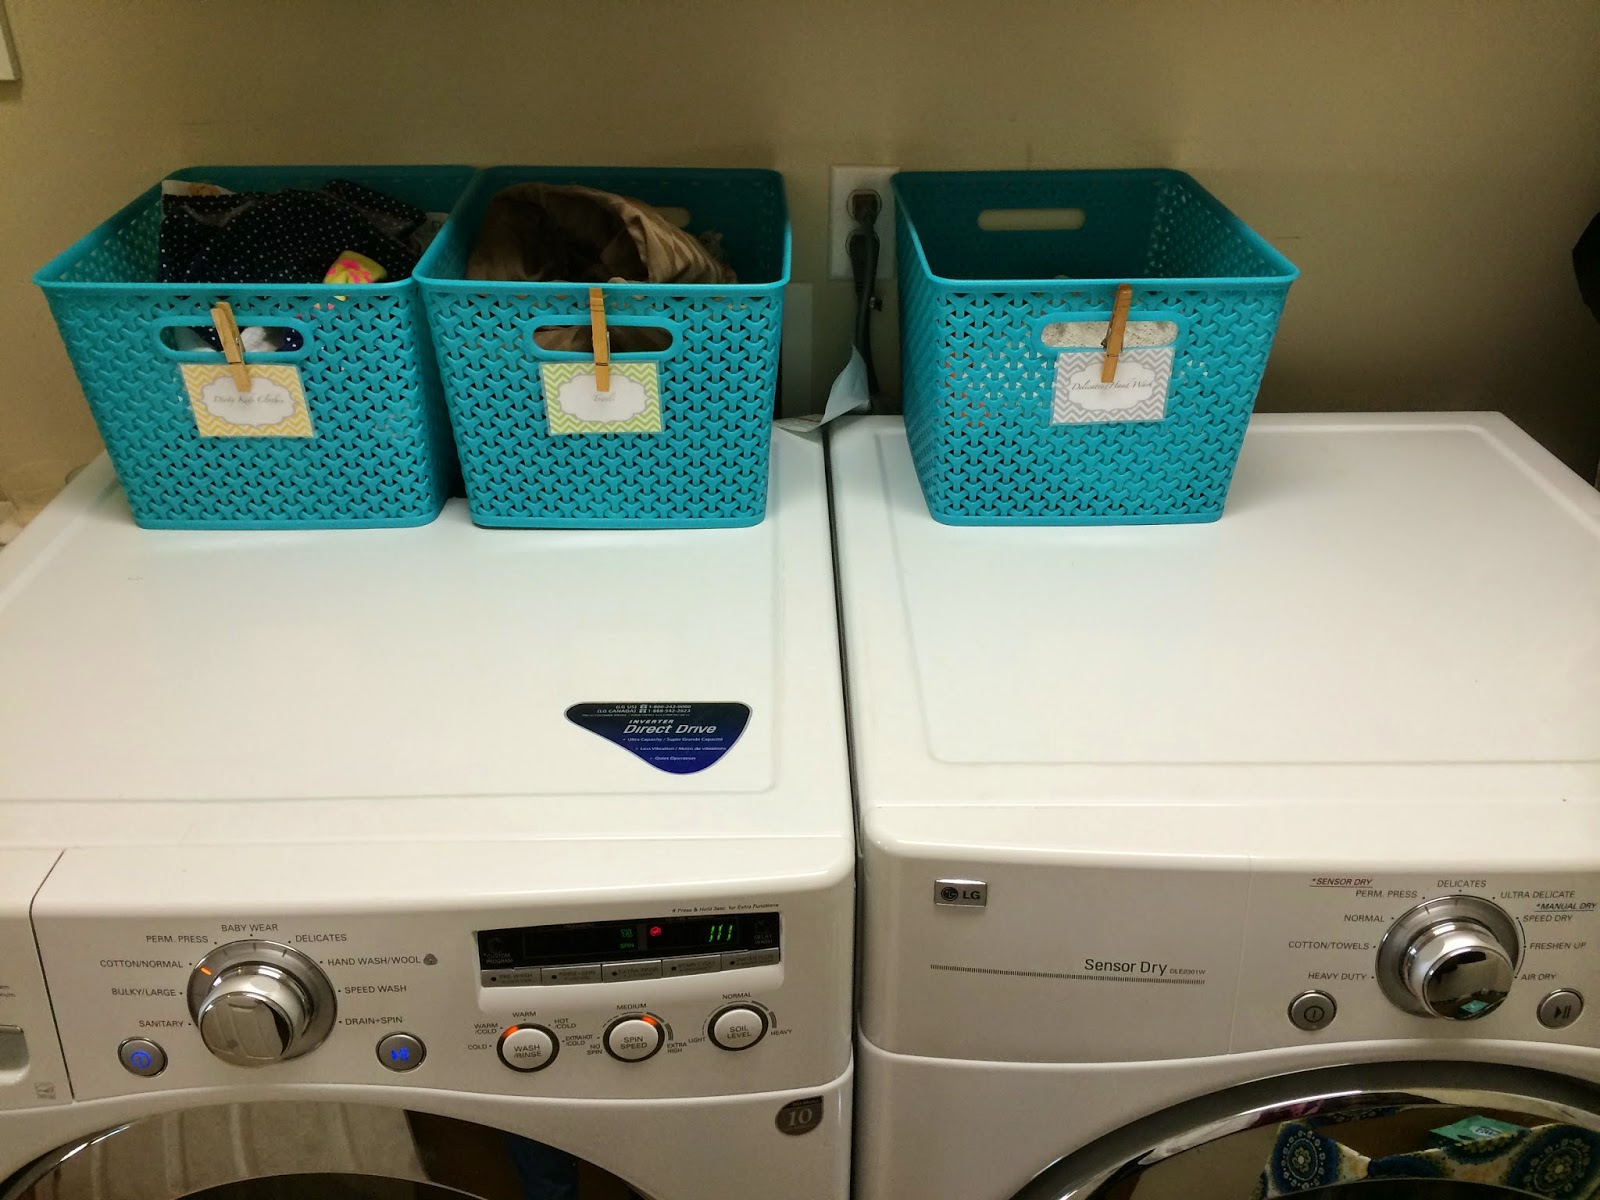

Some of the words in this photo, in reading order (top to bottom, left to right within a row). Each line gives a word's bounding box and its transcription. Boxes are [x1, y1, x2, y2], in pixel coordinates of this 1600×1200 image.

[623, 725, 671, 734] Direct
[675, 725, 717, 734] Drive
[1354, 878, 1373, 886] DRY
[1437, 879, 1487, 888] DELICATES
[962, 890, 981, 900] LG
[1387, 890, 1418, 899] PRESS
[1500, 891, 1530, 899] ULTRA
[1532, 890, 1576, 899] DELICATE
[1578, 902, 1598, 910] DRY
[1343, 914, 1385, 923] NORMAL
[1522, 914, 1553, 923] SPEED
[1554, 914, 1574, 922] DRY
[221, 924, 246, 932] BABY
[249, 924, 278, 932] WEAR
[177, 935, 209, 943] PRESS
[295, 933, 348, 943] DELICATES
[1288, 941, 1370, 950] COTTON/TOWELS
[1529, 942, 1572, 950] FRESHEN
[1574, 942, 1587, 950] UP
[99, 959, 184, 969] COTTON/NORMAL
[327, 957, 356, 966] HAND
[357, 956, 421, 965] WASH/WOOL
[1084, 958, 1137, 973] Sensor
[1140, 961, 1168, 976] Dry
[1307, 972, 1339, 980] HEAVY
[1341, 973, 1367, 981] DUTY
[1520, 973, 1537, 981] AIR
[1538, 973, 1557, 981] DRY
[111, 987, 177, 997] BULKY/LARGE
[344, 986, 375, 994] SPEED
[377, 984, 408, 993] WASH
[722, 992, 752, 1000] NORMAL
[138, 1020, 184, 1028] SANITARY
[345, 1016, 403, 1026] DRAIN+SPIN
[729, 1025, 748, 1033] SOIL
[726, 1031, 751, 1039] LEVEL
[688, 1036, 706, 1044] LIGHT
[514, 1044, 541, 1052] WASH
[620, 1042, 648, 1050] SPEED
[513, 1051, 542, 1059] /RINSE
[789, 1108, 813, 1126] 10
